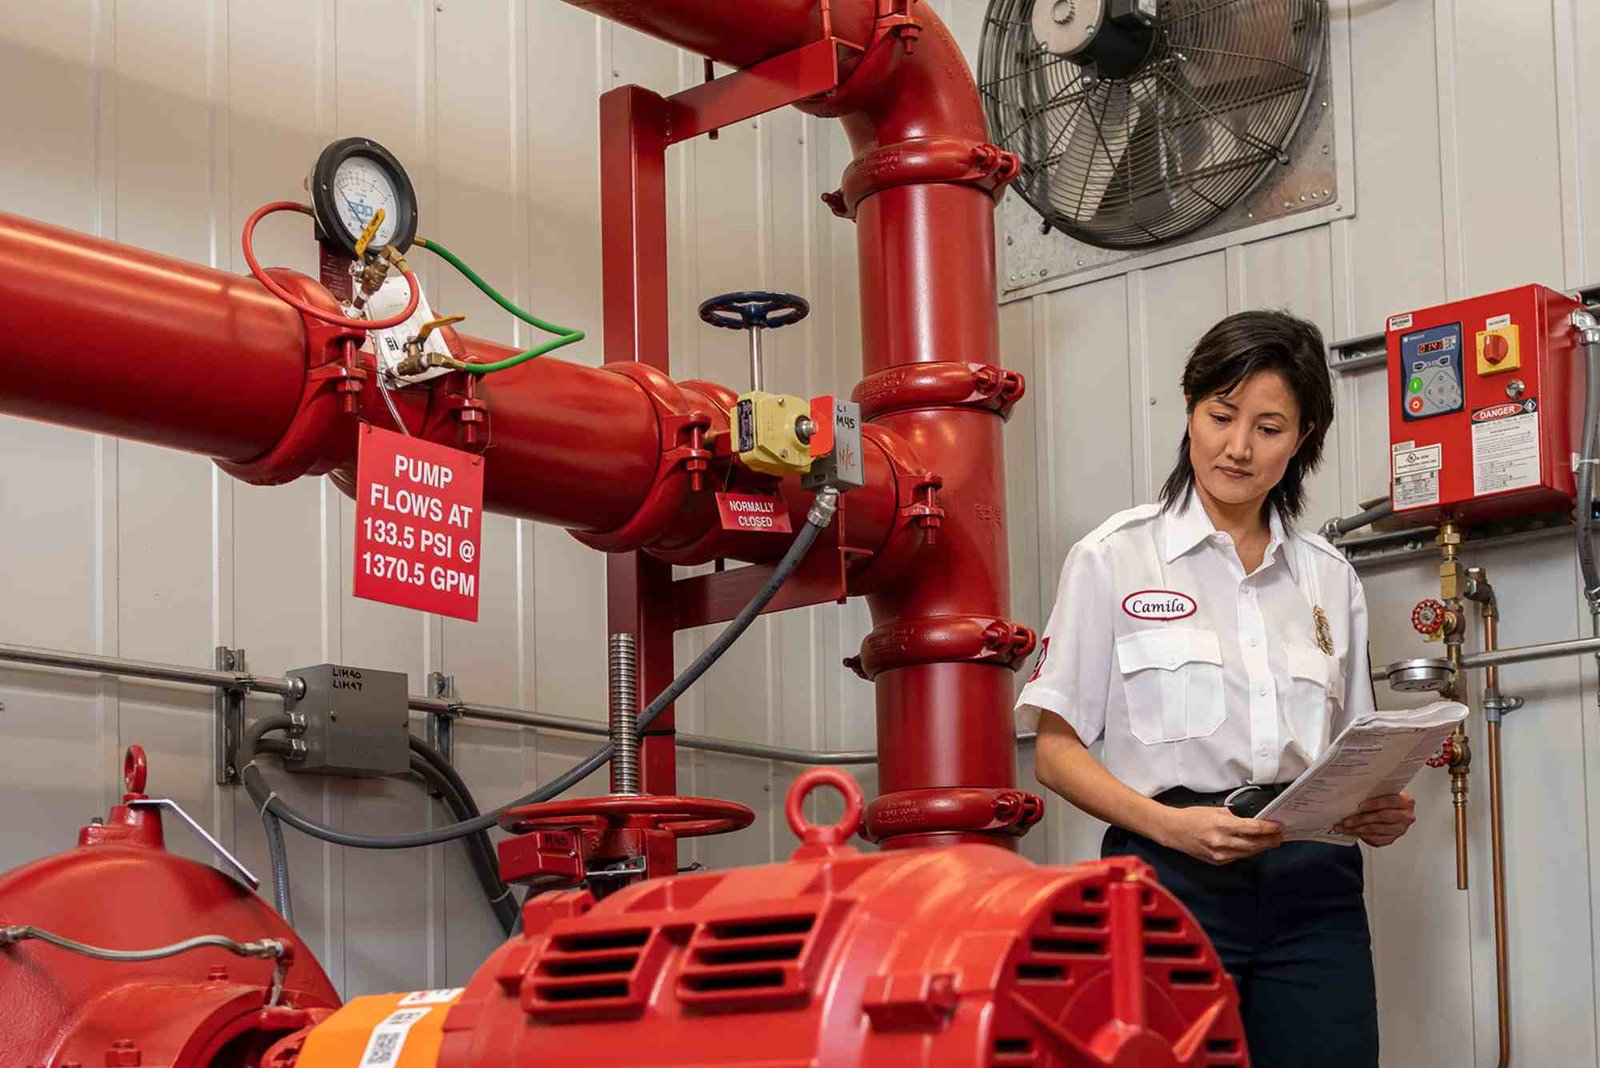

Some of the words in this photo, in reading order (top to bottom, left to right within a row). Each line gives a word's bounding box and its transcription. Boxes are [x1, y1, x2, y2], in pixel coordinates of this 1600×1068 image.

[1479, 405, 1516, 421] DANGER
[394, 454, 453, 489] PUMP
[370, 483, 443, 522] FLOWS
[448, 504, 473, 529] AT
[729, 500, 774, 513] NORMALLY
[738, 516, 773, 528] CLOSED
[363, 517, 414, 550] 133.5
[420, 530, 452, 559] PSI
[459, 540, 475, 563] @
[362, 551, 425, 586] 1370.5
[430, 567, 475, 597] GPM
[1132, 598, 1186, 614] Camila
